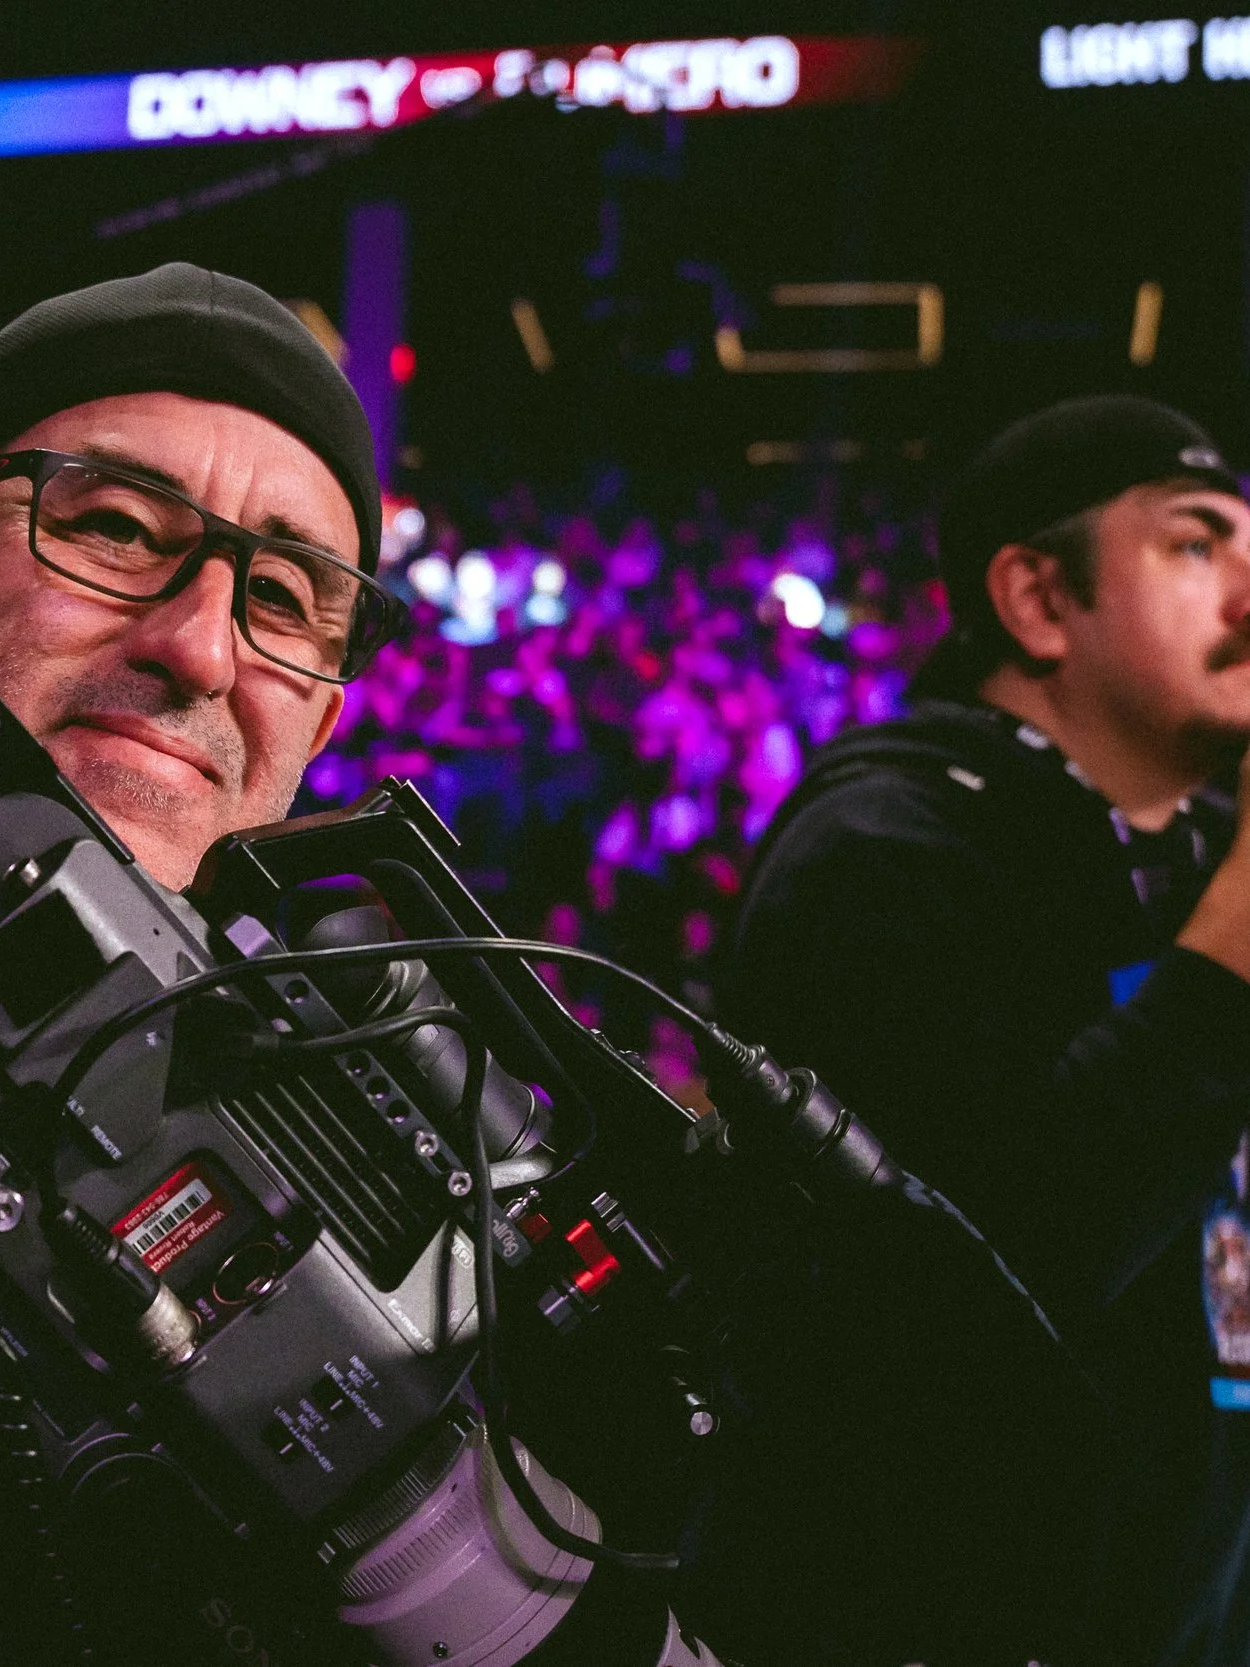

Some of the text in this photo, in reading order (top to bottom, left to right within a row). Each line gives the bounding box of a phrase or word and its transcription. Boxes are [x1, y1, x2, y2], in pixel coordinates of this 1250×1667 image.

[127, 56, 417, 140] DOWNEY
[91, 1124, 122, 1160] REMOTE
[187, 1209, 225, 1242] Vantage
[347, 1369, 364, 1388] MIC
[350, 1355, 374, 1381] INPUT
[297, 1413, 314, 1432] MIC
[299, 1398, 323, 1424] INPUT
